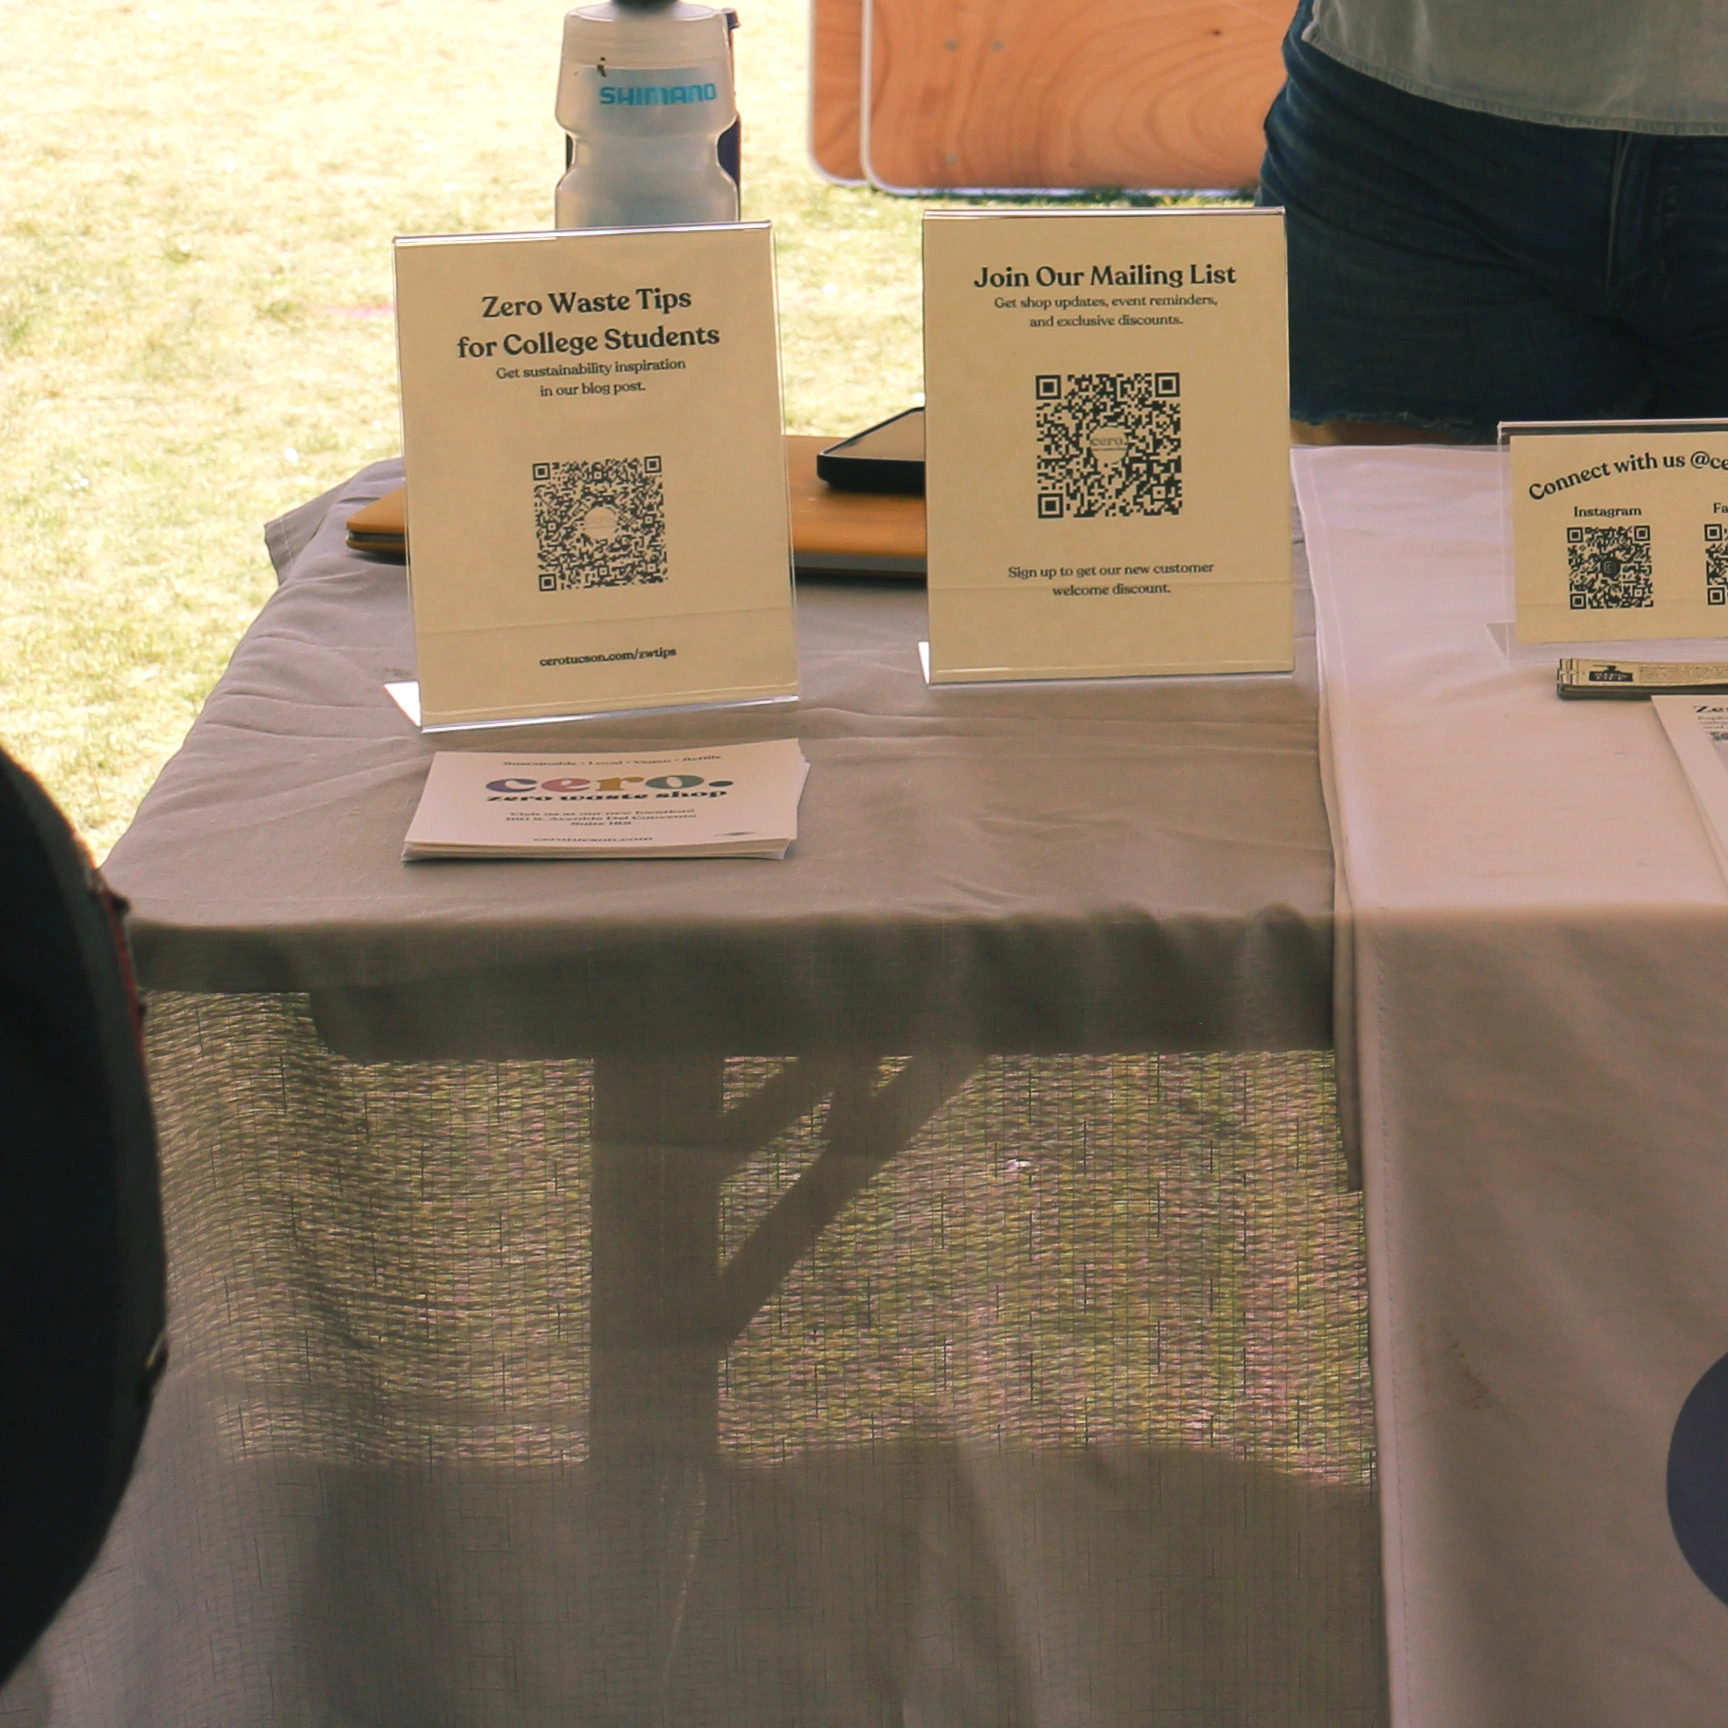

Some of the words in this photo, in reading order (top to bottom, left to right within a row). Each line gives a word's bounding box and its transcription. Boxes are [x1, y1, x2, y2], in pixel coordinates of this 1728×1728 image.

[599, 83, 717, 106] SHIMANO
[974, 266, 1030, 288] Join
[1036, 266, 1085, 288] Our
[1090, 264, 1183, 288] Mailing
[1190, 264, 1238, 284] List
[482, 295, 543, 318] Zero
[548, 292, 631, 314] Waste
[636, 288, 692, 314] Tips
[994, 297, 1017, 309] Get
[1020, 296, 1051, 310] shop
[1054, 296, 1109, 310] updates,
[1112, 296, 1146, 307] event
[1149, 294, 1218, 306] reminders,
[1030, 316, 1054, 328] and
[1057, 315, 1115, 328] exclusive
[1118, 314, 1183, 326] discounts.
[456, 336, 498, 358] for
[503, 332, 599, 356] College
[604, 326, 720, 350] Students
[496, 367, 519, 380] Get
[523, 362, 613, 378] sustainability
[615, 358, 686, 374] inspiration
[540, 385, 553, 397] in
[556, 386, 579, 396] our
[582, 382, 611, 396] blog
[613, 381, 646, 396] post.
[1528, 461, 1612, 501] Connect
[1612, 452, 1658, 474] with
[1662, 454, 1686, 469] us
[1573, 505, 1642, 519] Instagram
[1008, 566, 1038, 580] Sign
[1040, 569, 1057, 580] up
[1060, 568, 1074, 577] to
[1076, 567, 1097, 579] get
[1099, 566, 1122, 576] our
[1124, 566, 1150, 576] new
[1152, 562, 1216, 574] customer
[1052, 584, 1110, 596] welcome
[1112, 583, 1171, 595] discount.
[539, 646, 677, 668] cerotucson.com/zwtips
[486, 774, 734, 793] cero.
[487, 794, 552, 802] zero
[560, 792, 649, 802] waste
[655, 790, 728, 799] shop
